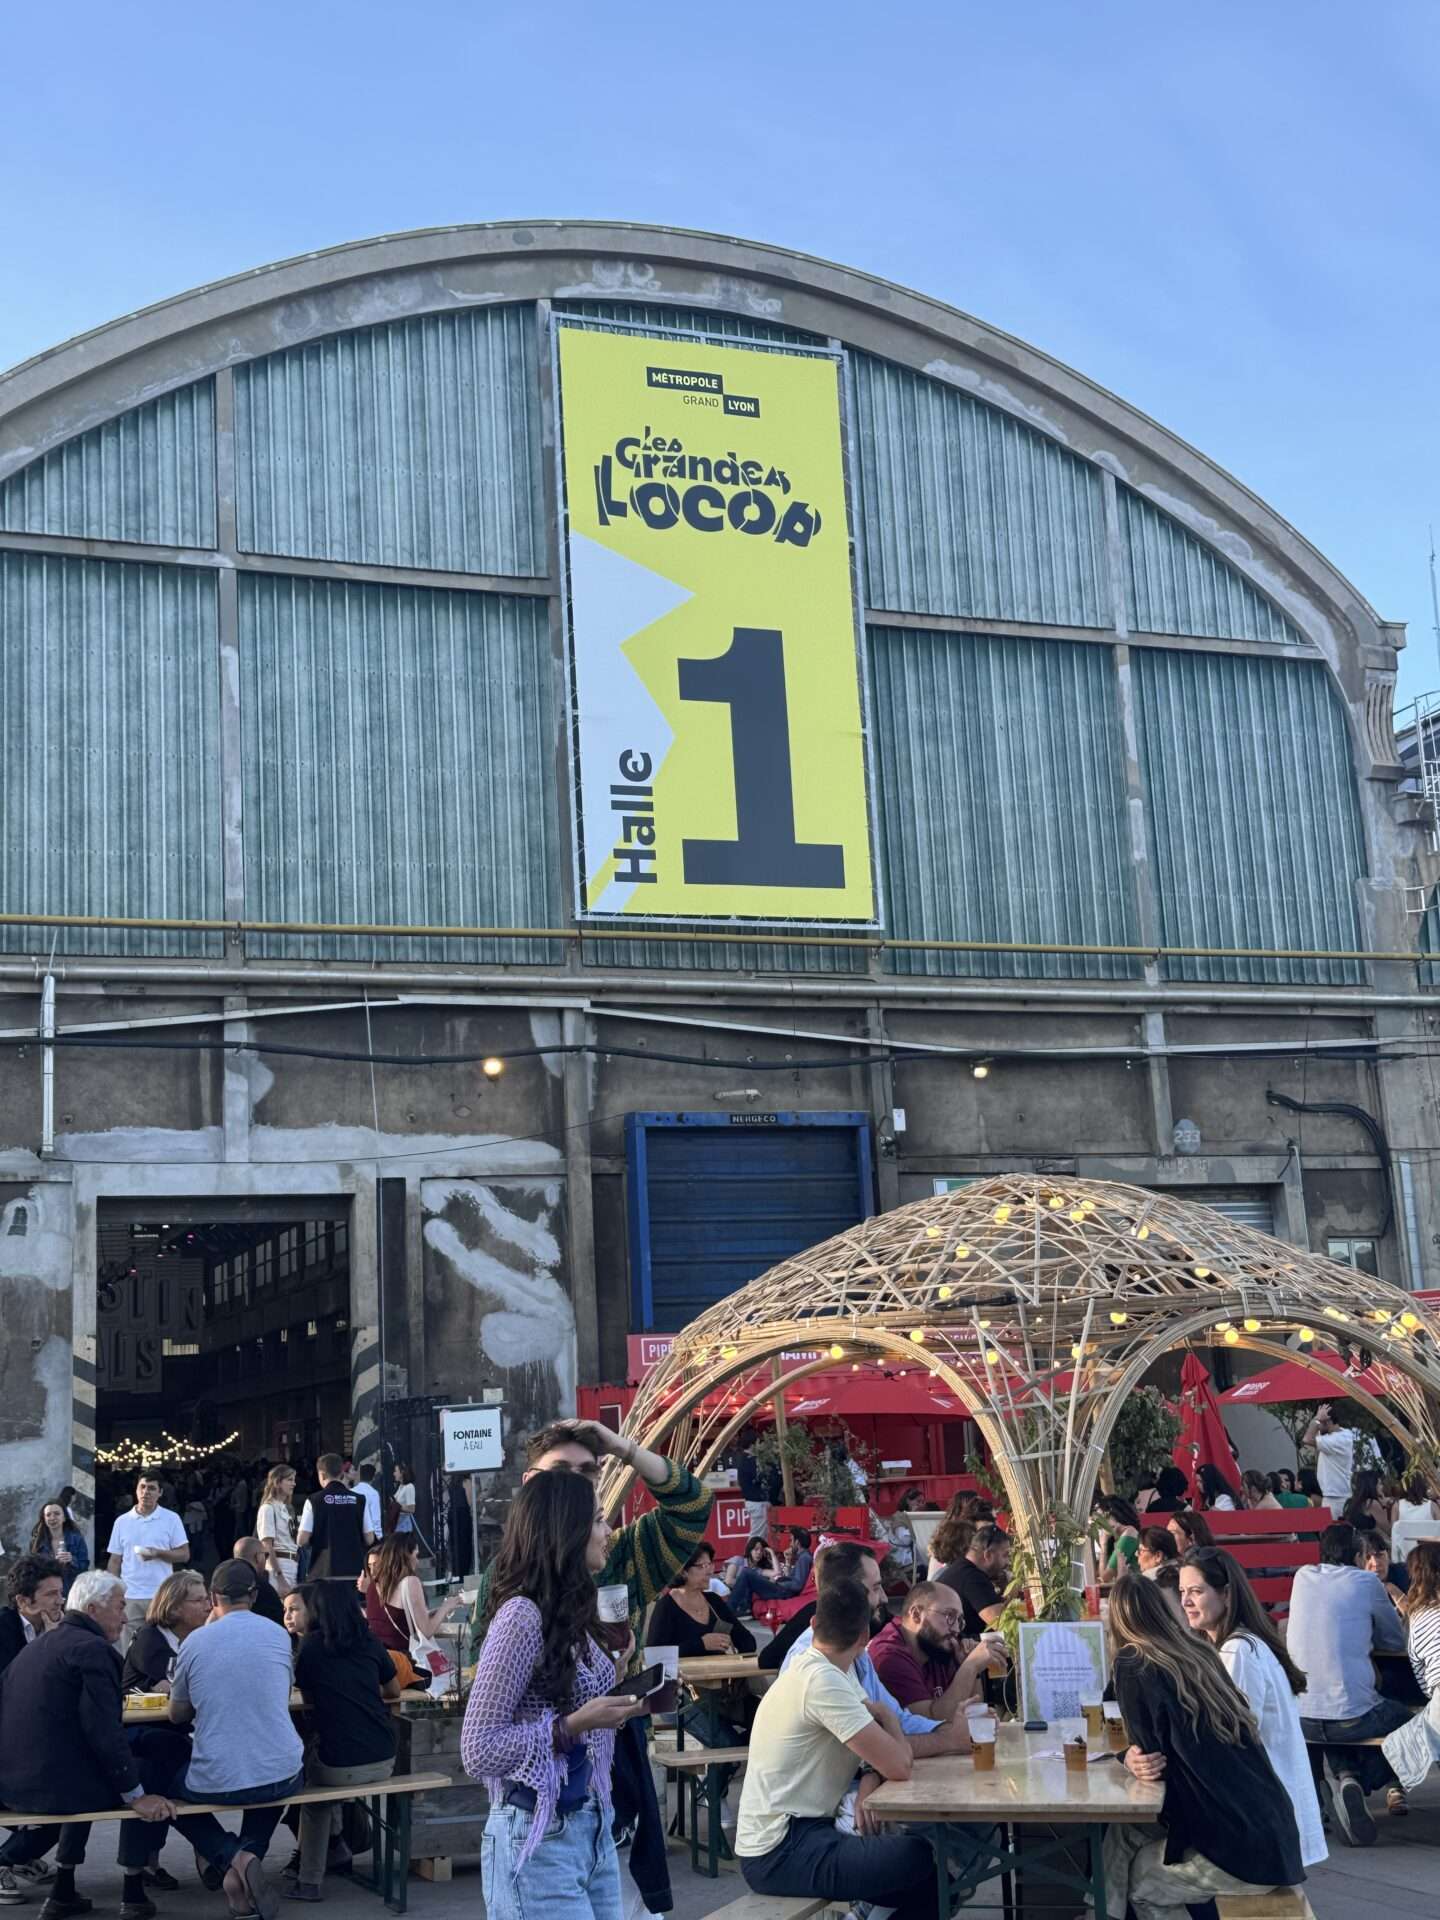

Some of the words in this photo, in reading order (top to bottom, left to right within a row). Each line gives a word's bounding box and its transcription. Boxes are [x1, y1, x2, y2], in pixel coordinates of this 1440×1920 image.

[651, 371, 719, 389] MÉTROPOLE
[682, 395, 719, 408] GRAND
[728, 399, 755, 413] LYON
[677, 627, 846, 889] 1
[610, 749, 658, 883] Halle
[453, 1429, 492, 1440] FONTAINE
